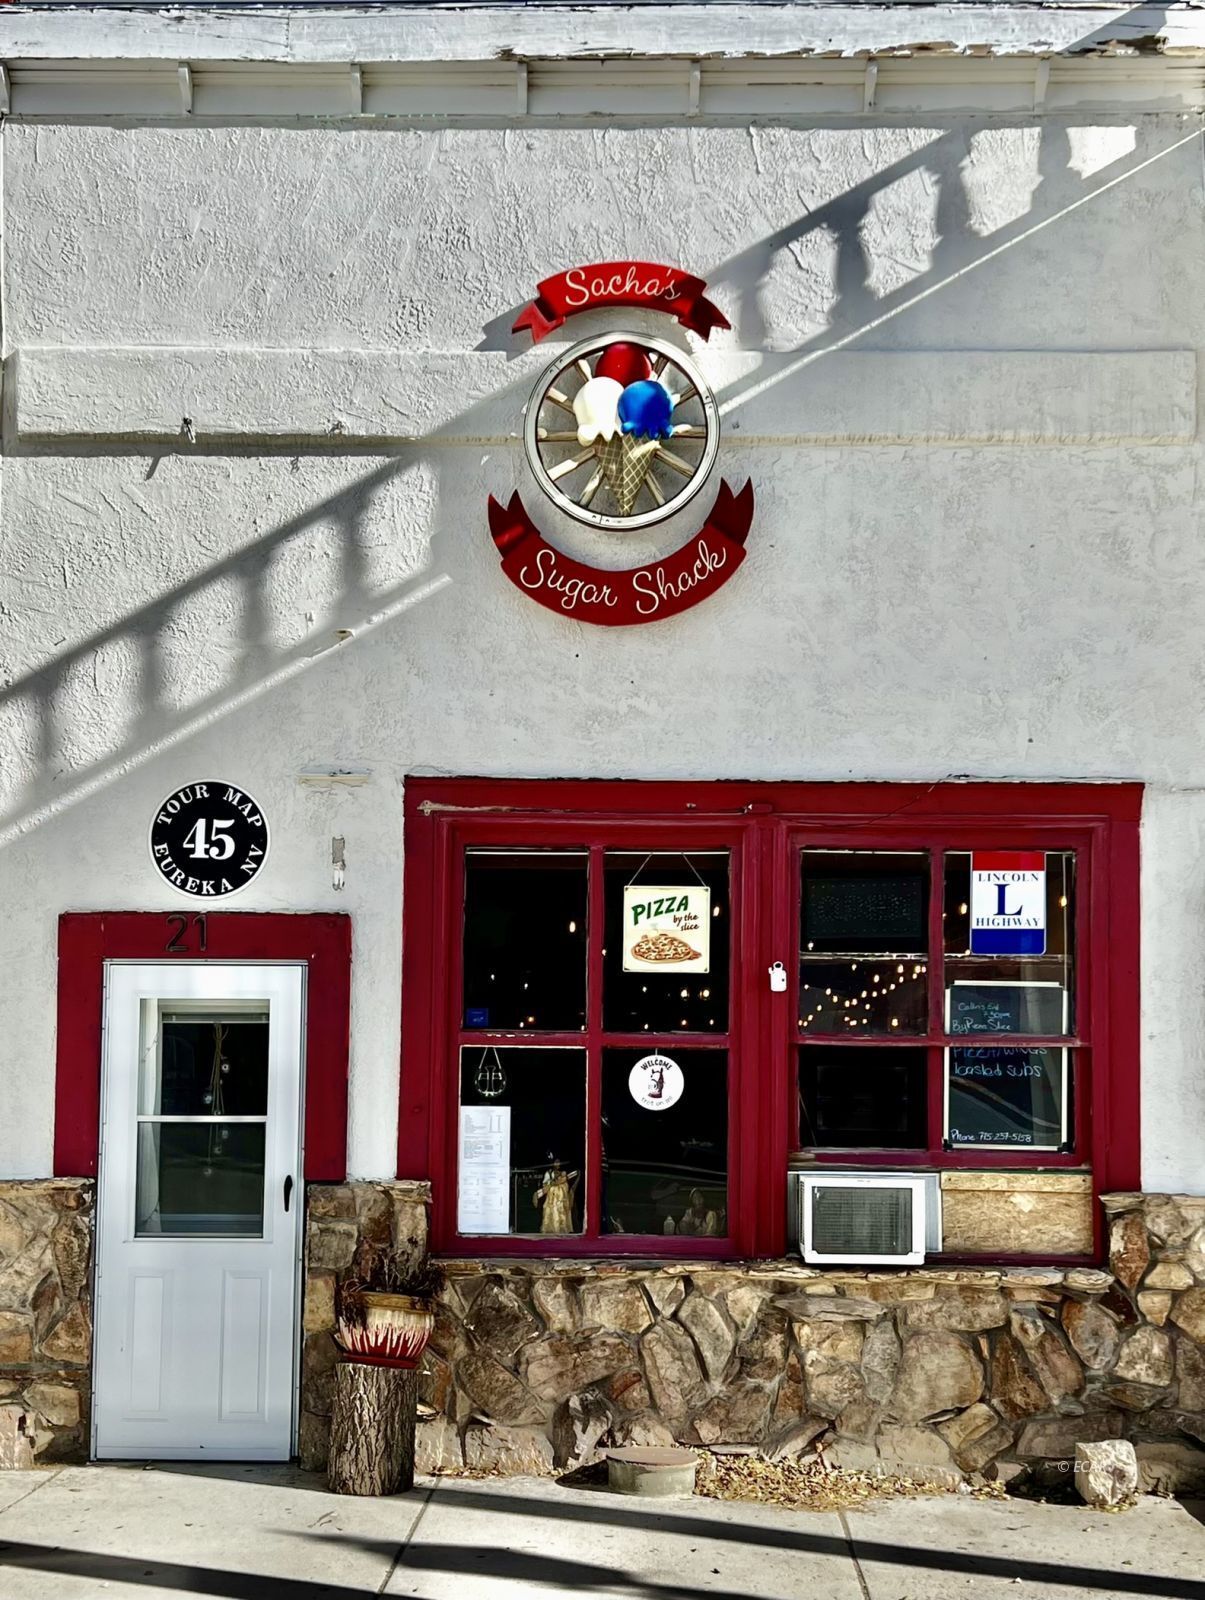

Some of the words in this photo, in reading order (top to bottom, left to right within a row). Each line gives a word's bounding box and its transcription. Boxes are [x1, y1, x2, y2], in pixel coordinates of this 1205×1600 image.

[565, 266, 681, 306] Sacha's
[520, 549, 618, 610] Sugar
[632, 540, 727, 614] Shack
[157, 784, 210, 826] TOUR
[222, 787, 263, 828] MAP
[182, 818, 236, 861] 45
[154, 843, 234, 895] EUREKA
[240, 844, 264, 875] NV
[978, 873, 1040, 882] LINCOLN
[631, 895, 689, 926] PIZZA
[993, 883, 1024, 916] L
[165, 913, 208, 952] 21
[673, 914, 683, 928] by
[684, 912, 699, 921] the
[680, 922, 700, 932] slice
[975, 918, 1041, 927] HIGHWAY
[640, 1059, 673, 1071] WELCOME
[950, 1128, 976, 1142] Phone
